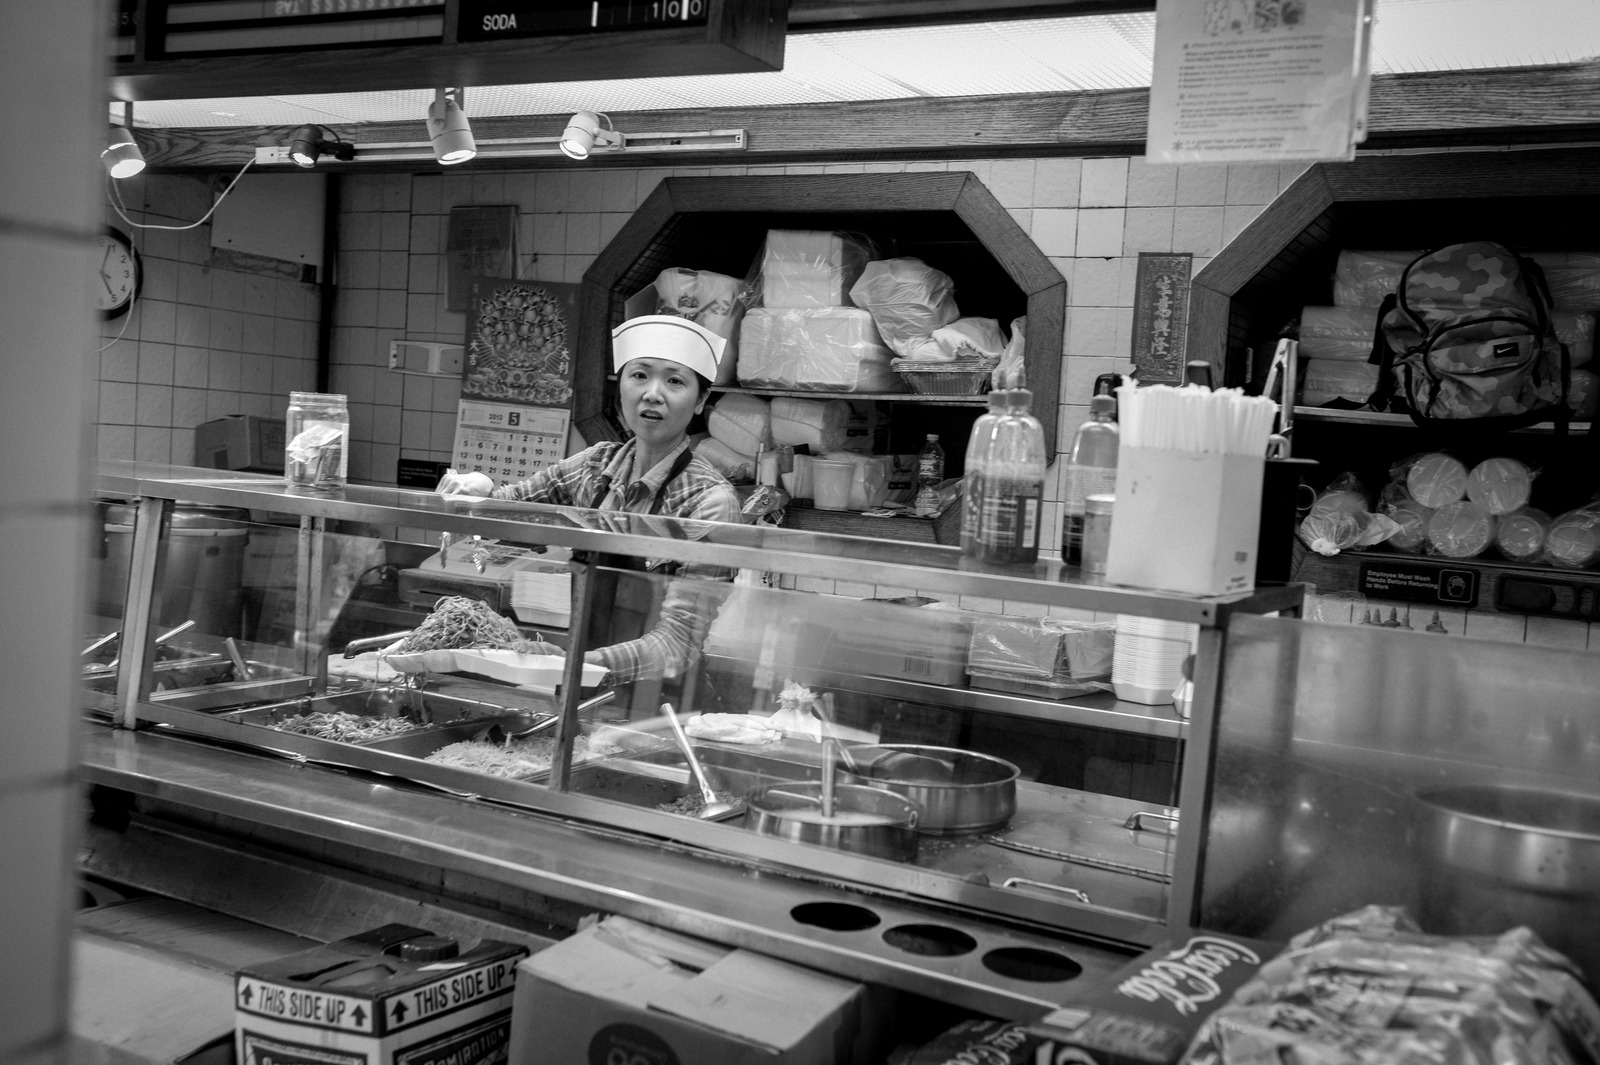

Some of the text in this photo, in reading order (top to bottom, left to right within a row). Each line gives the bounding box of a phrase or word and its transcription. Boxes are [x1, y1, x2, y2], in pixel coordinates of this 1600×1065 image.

[482, 13, 517, 31] SODA
[120, 255, 127, 264] 2
[124, 270, 130, 278] 3
[111, 294, 117, 303] 5
[469, 340, 479, 366] 大吉
[558, 348, 571, 375] 大利
[511, 413, 518, 425] 5
[1367, 570, 1397, 579] Employee
[1408, 580, 1438, 590] Returning
[414, 963, 506, 1017] THIS SIDE UP
[259, 985, 346, 1026] THIS SIDE UP
